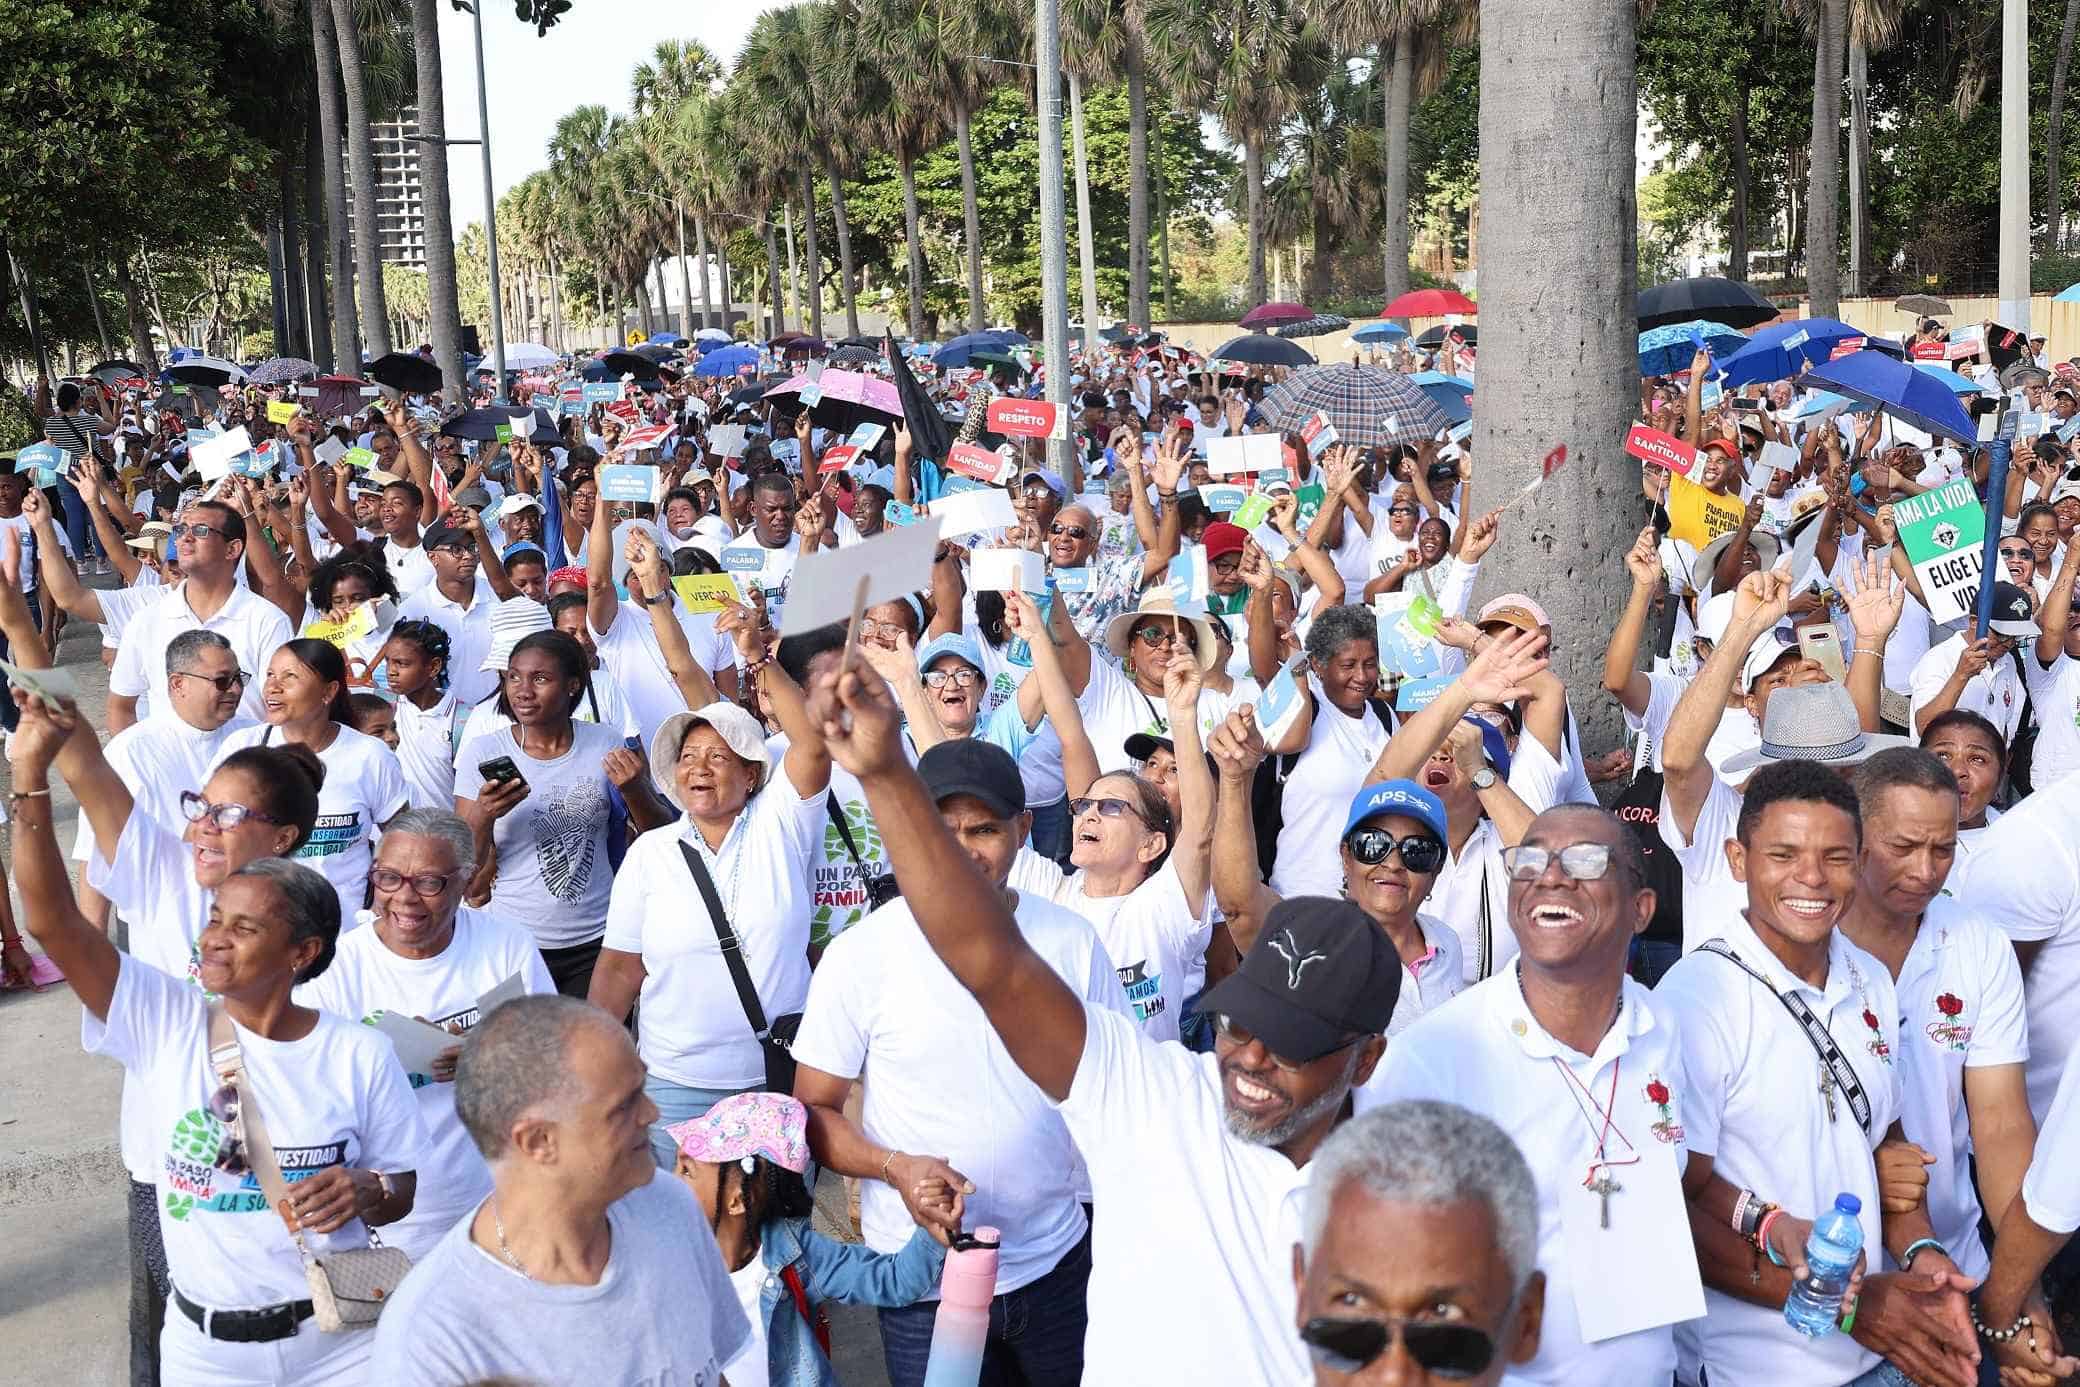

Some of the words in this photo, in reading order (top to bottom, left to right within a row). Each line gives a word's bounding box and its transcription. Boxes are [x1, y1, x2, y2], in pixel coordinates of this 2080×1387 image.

[998, 412, 1046, 427] RESPETO
[1634, 436, 1688, 466] SANTIDAD
[953, 454, 996, 473] SANTIDAD
[1893, 500, 1925, 528] AMA
[1921, 493, 1944, 517] LA
[1940, 480, 1977, 511] VIDA
[726, 556, 759, 564] PALABRA
[1928, 556, 1972, 589] ELIGE
[1970, 549, 1985, 574] L
[1952, 585, 1979, 612] VID
[1368, 790, 1407, 807] APS
[816, 867, 838, 882] UN
[843, 861, 883, 881] PASO
[816, 881, 853, 892] POR
[814, 890, 865, 907] FAMIL
[1126, 980, 1156, 1001] AMOS
[179, 1161, 213, 1179] PASO
[218, 1194, 237, 1211] LA
